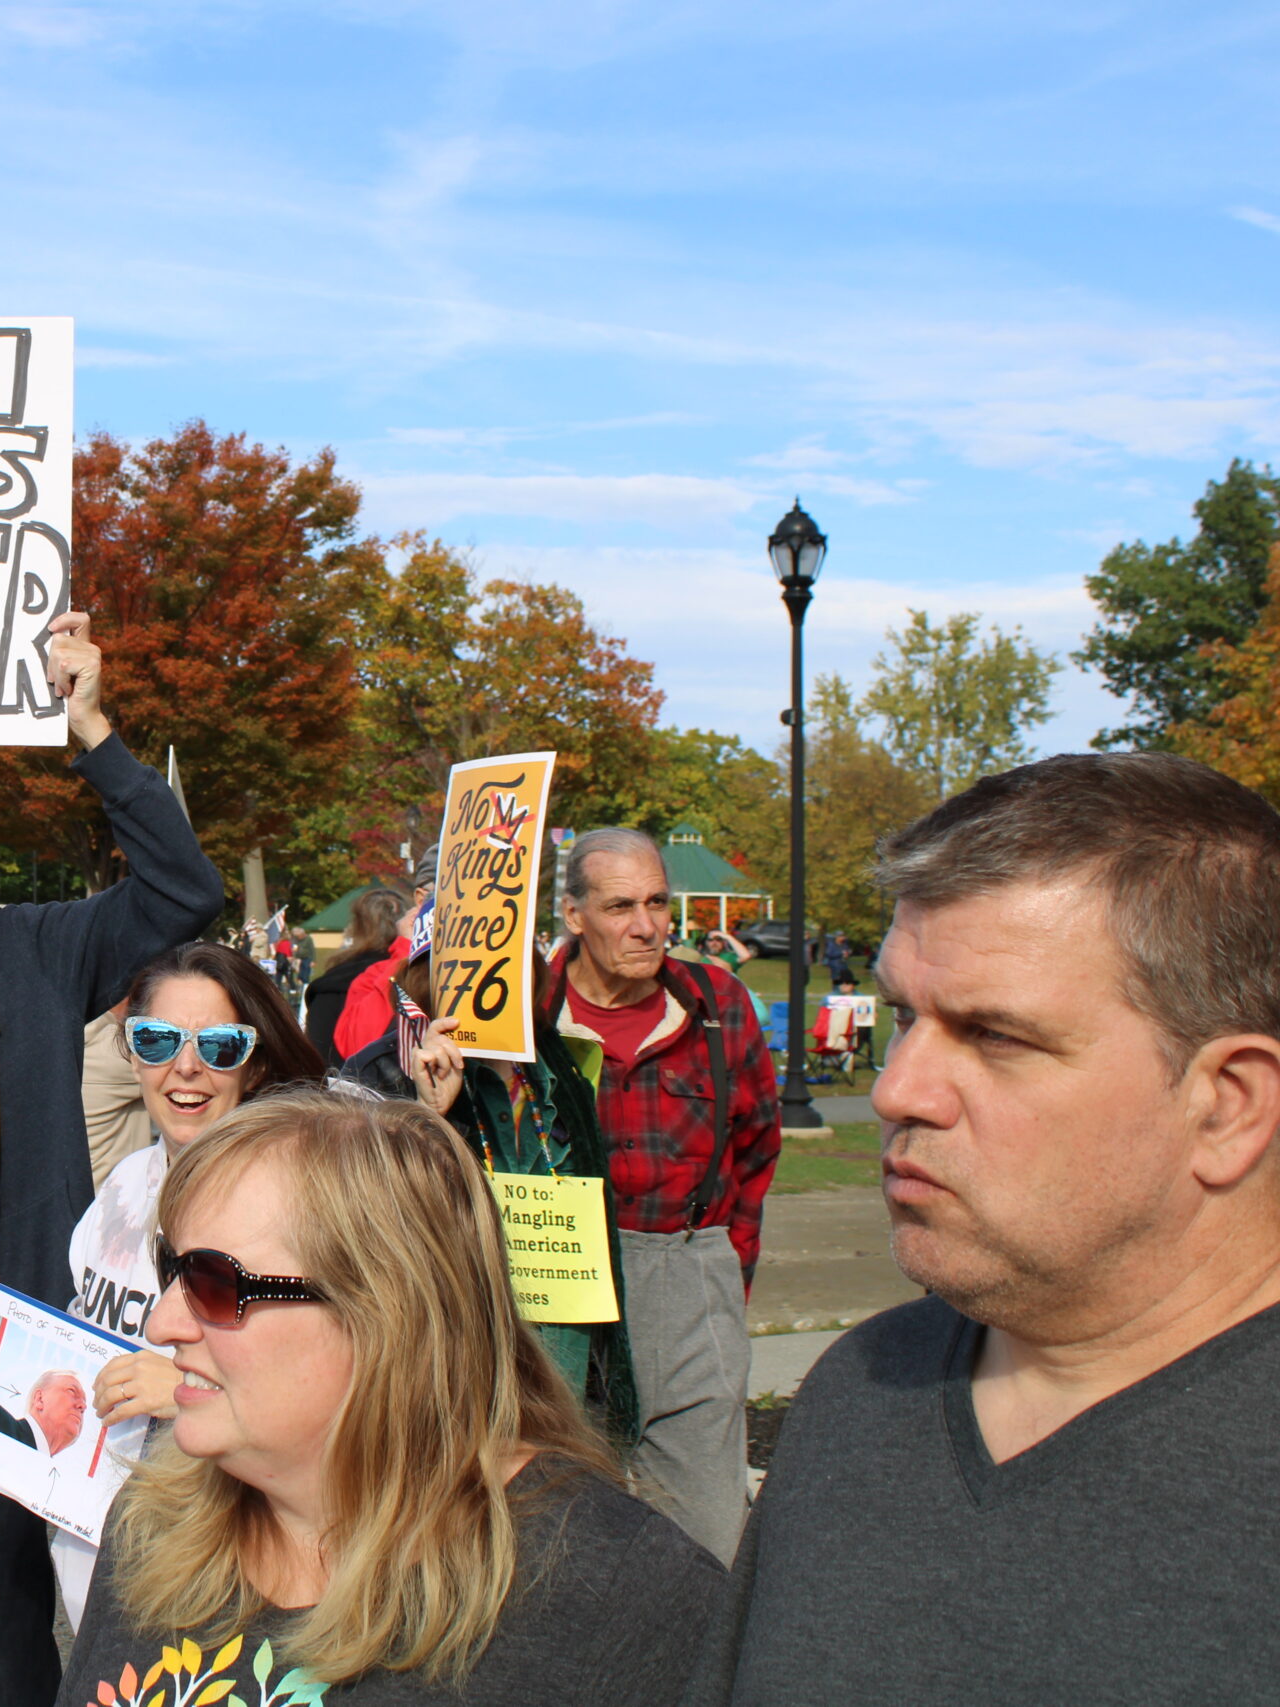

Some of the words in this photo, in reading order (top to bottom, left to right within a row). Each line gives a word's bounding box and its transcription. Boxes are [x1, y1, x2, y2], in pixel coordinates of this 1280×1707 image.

[451, 773, 526, 836] No
[441, 838, 527, 900] Kings
[435, 898, 518, 955] Since
[434, 956, 511, 1021] 1776
[505, 1184, 527, 1200] NO
[533, 1186, 554, 1201] to:
[7, 1301, 32, 1324] PHOTO
[36, 1320, 49, 1329] OF
[54, 1325, 75, 1342] THE
[82, 1338, 108, 1360] YEAR
